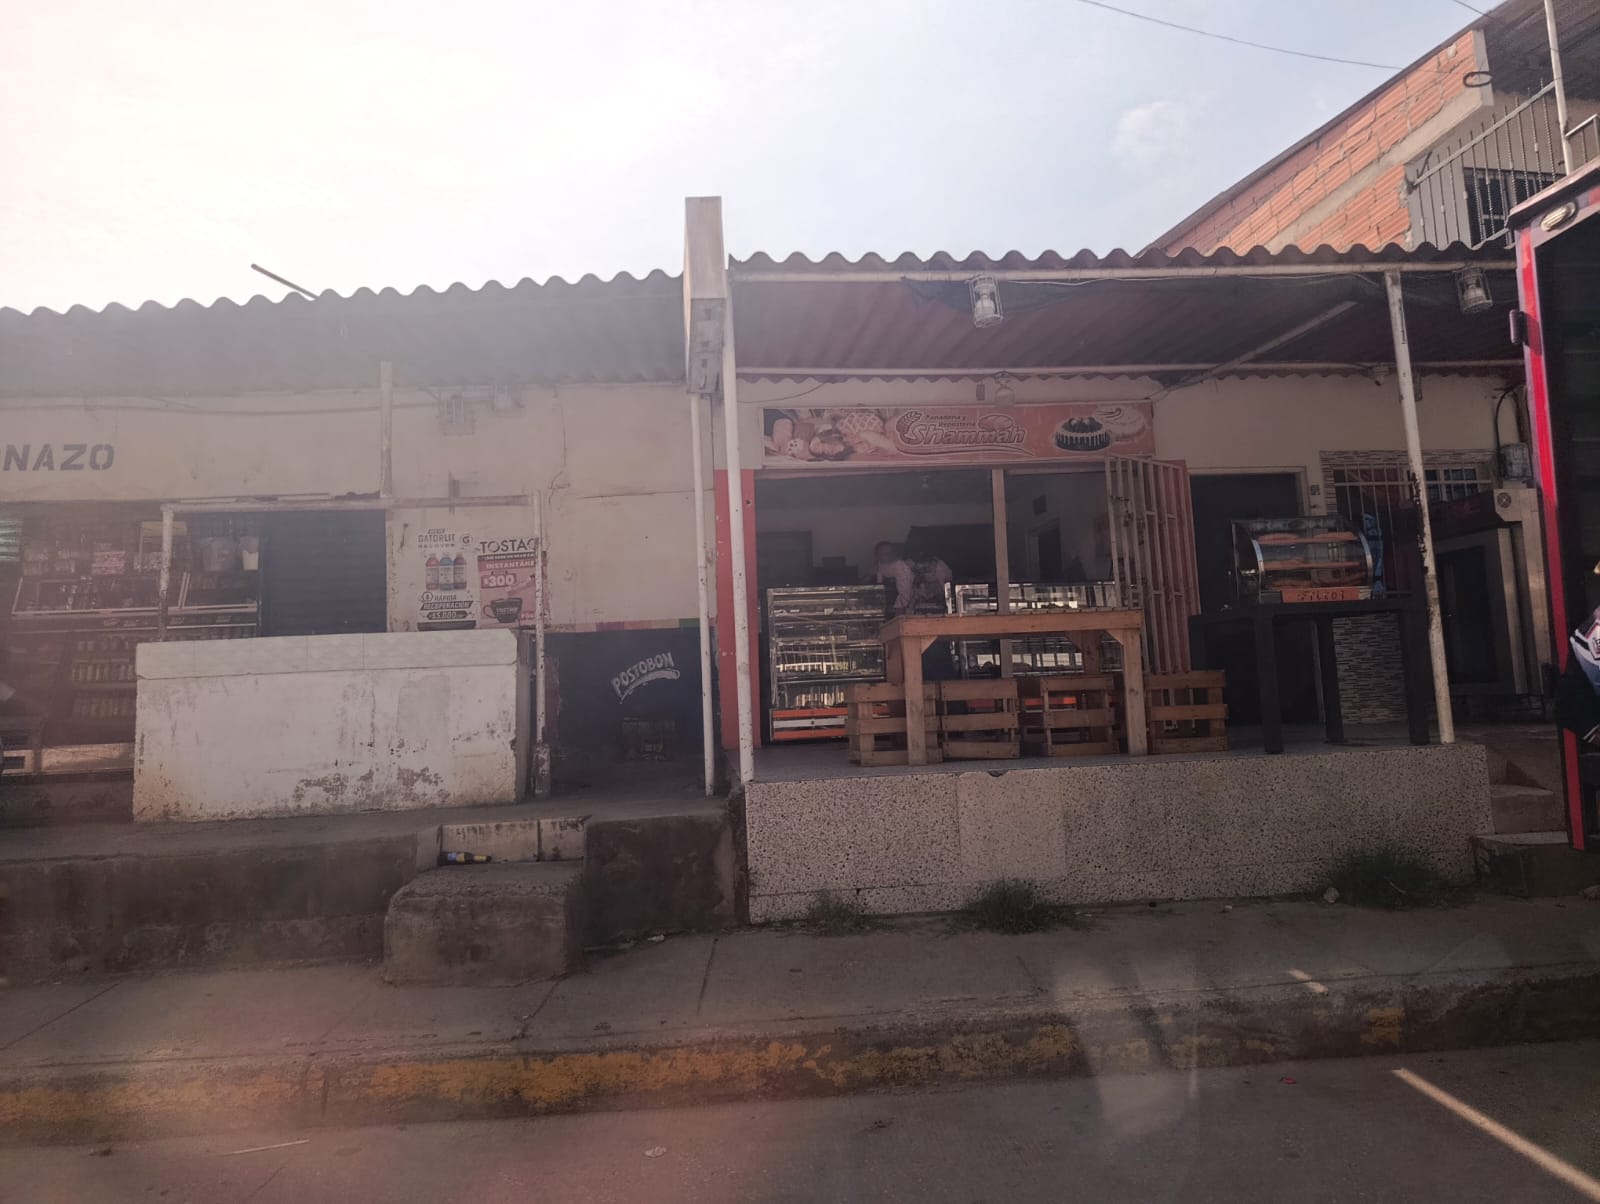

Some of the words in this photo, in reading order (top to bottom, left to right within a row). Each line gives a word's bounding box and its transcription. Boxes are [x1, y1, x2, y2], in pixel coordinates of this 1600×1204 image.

[903, 423, 1026, 446] Shammah
[0, 443, 115, 472] NAZO
[486, 559, 536, 569] INSTANTÁNE
